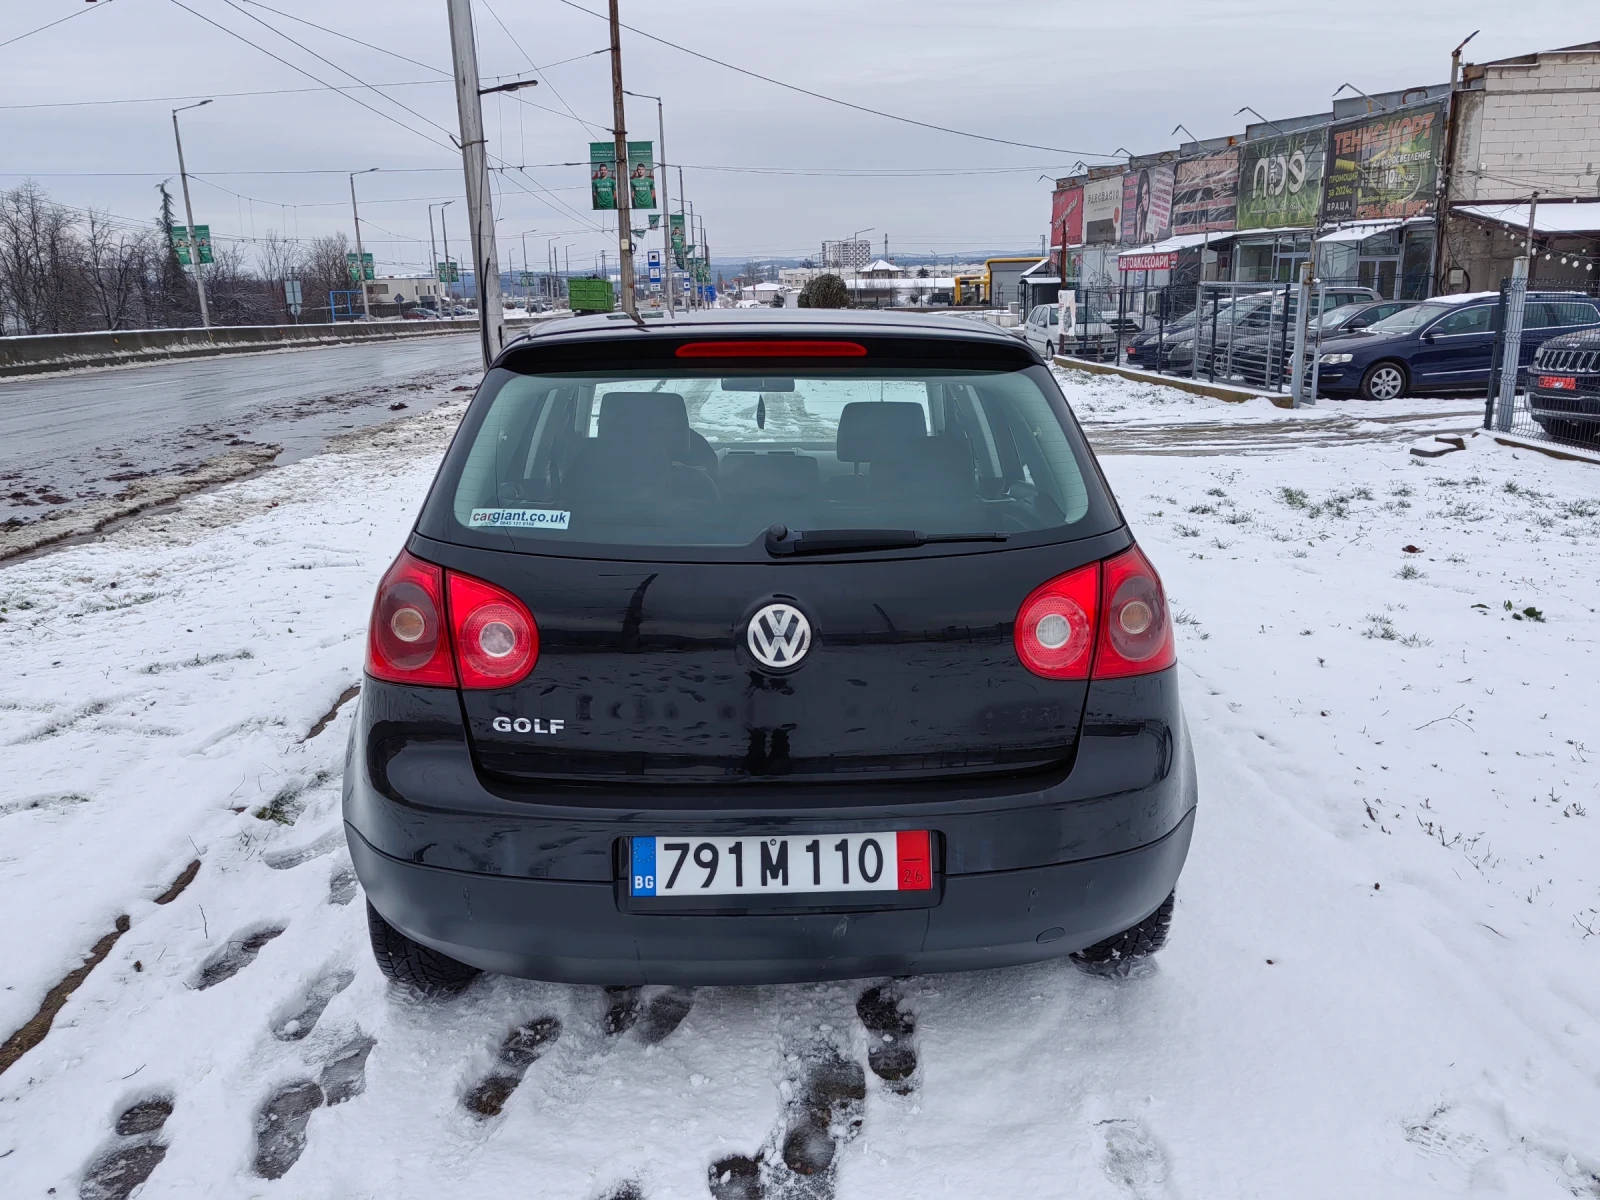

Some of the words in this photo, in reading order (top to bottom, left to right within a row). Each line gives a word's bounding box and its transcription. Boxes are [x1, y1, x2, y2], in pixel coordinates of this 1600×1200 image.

[1119, 255, 1169, 269] АВТОАКСЕСОАРИ
[472, 510, 567, 523] cargiant.co.uk
[492, 716, 565, 734] GOLF
[663, 840, 743, 889] 791
[760, 840, 789, 886] M
[805, 838, 884, 886] 110
[634, 875, 654, 889] BG
[903, 869, 924, 883] 26
